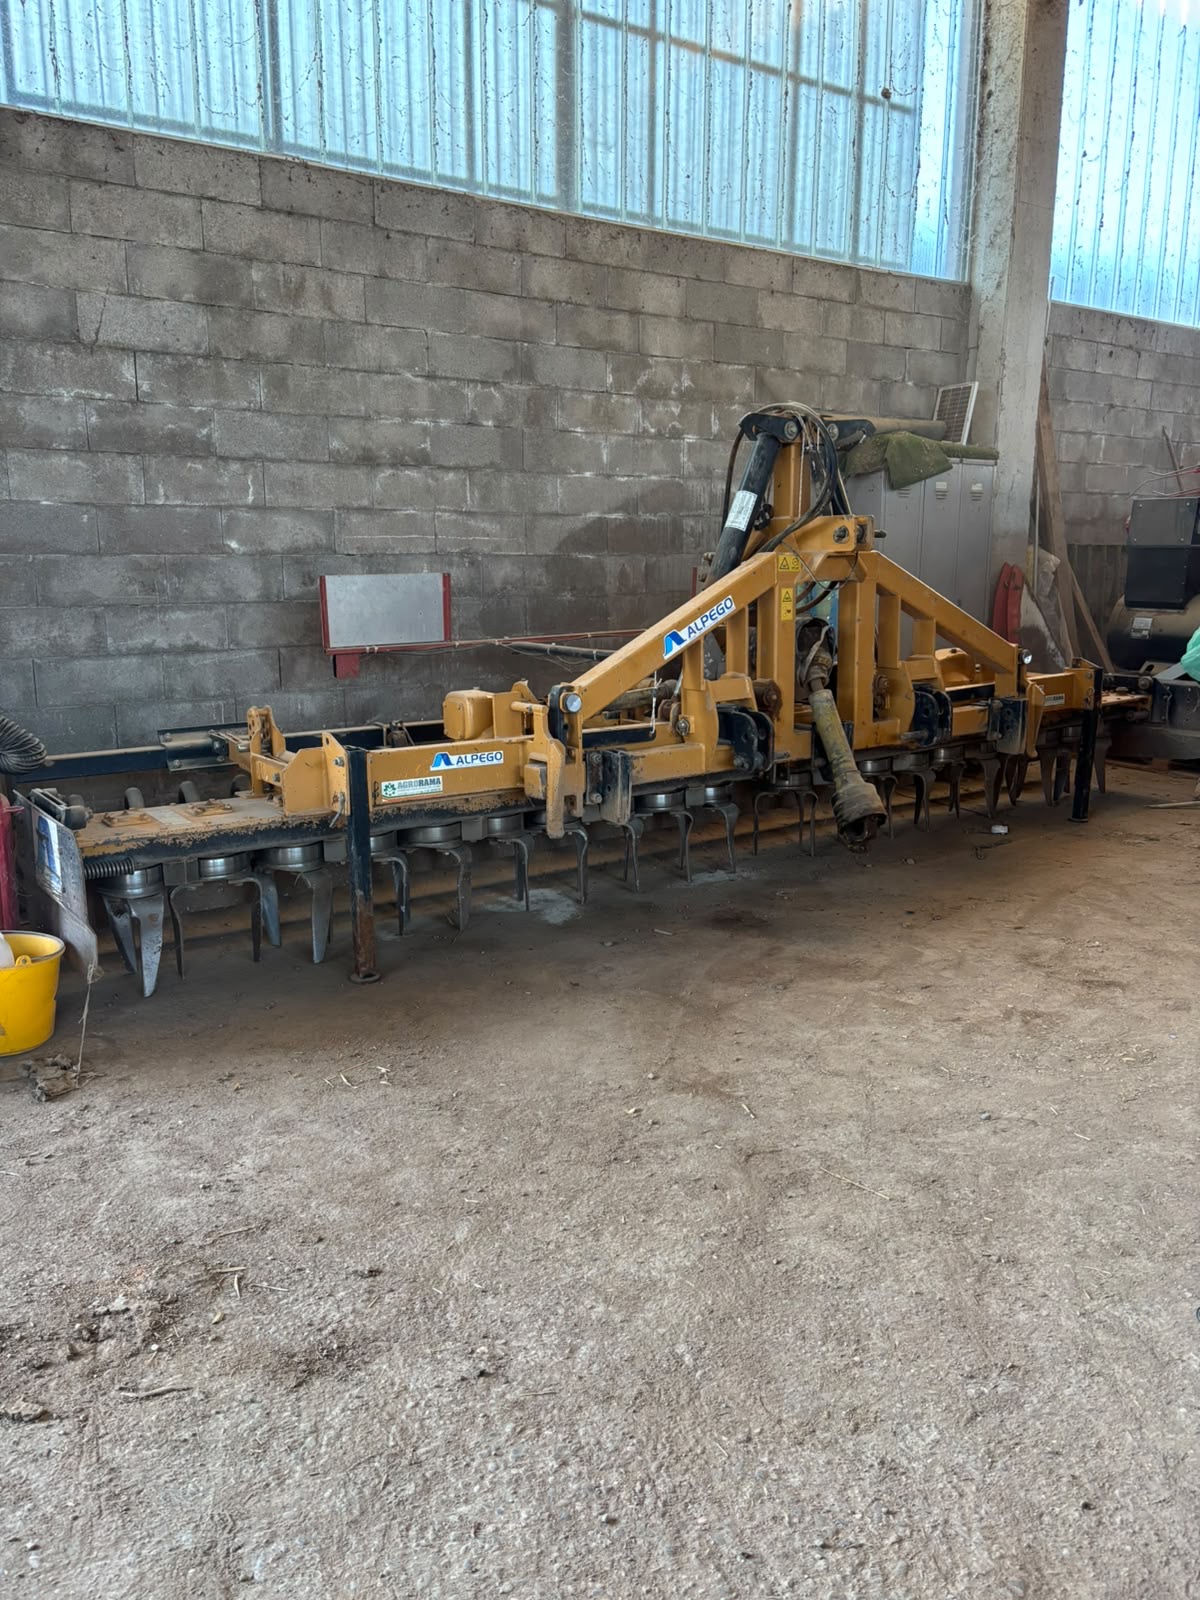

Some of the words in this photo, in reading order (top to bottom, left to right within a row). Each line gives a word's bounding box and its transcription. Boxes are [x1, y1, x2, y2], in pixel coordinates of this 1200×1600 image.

[687, 597, 734, 638] ALPEGO
[456, 751, 503, 765] ALPEGO
[397, 777, 441, 789] AGRORAMA
